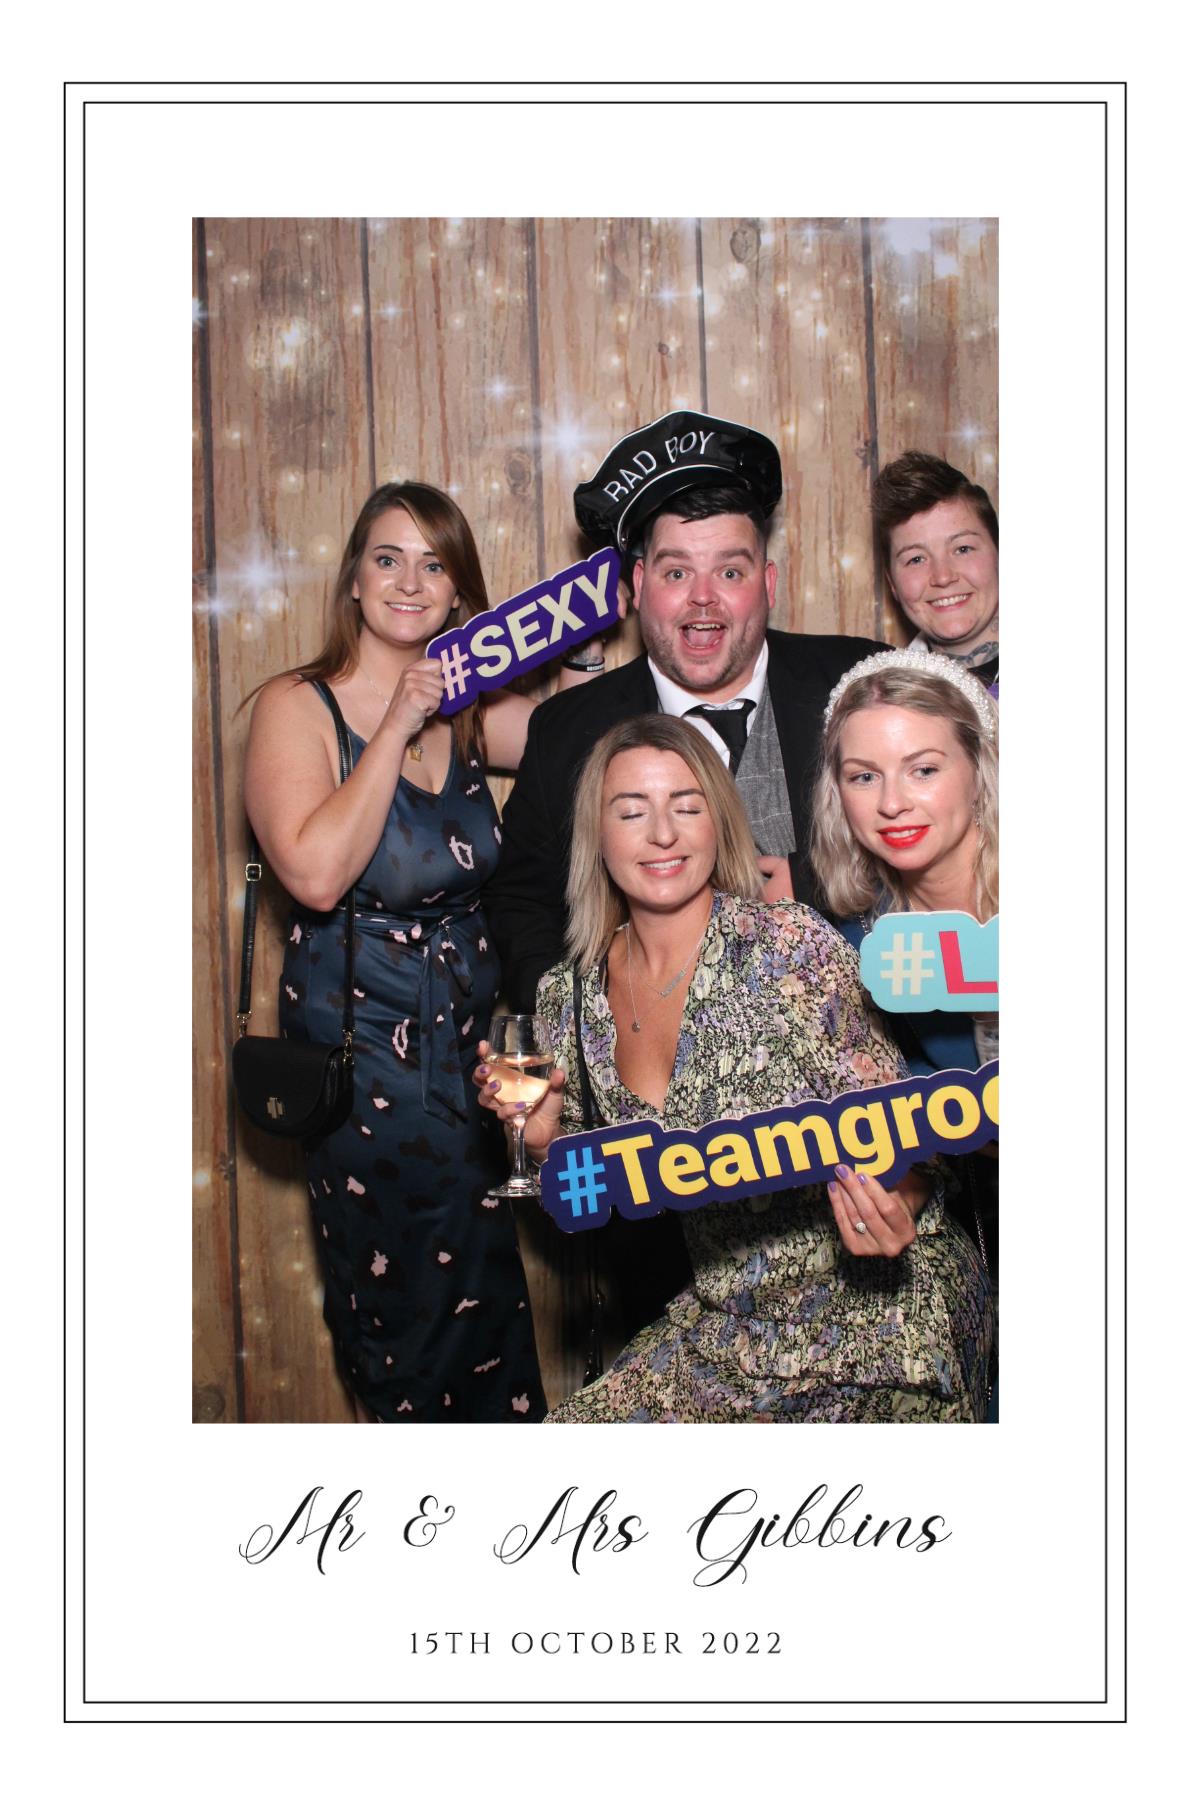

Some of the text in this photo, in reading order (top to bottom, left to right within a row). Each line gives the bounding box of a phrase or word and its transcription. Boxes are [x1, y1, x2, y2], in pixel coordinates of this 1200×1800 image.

[602, 430, 715, 503] BAD BOY
[440, 560, 611, 702] #SEXY
[879, 930, 999, 996] #L
